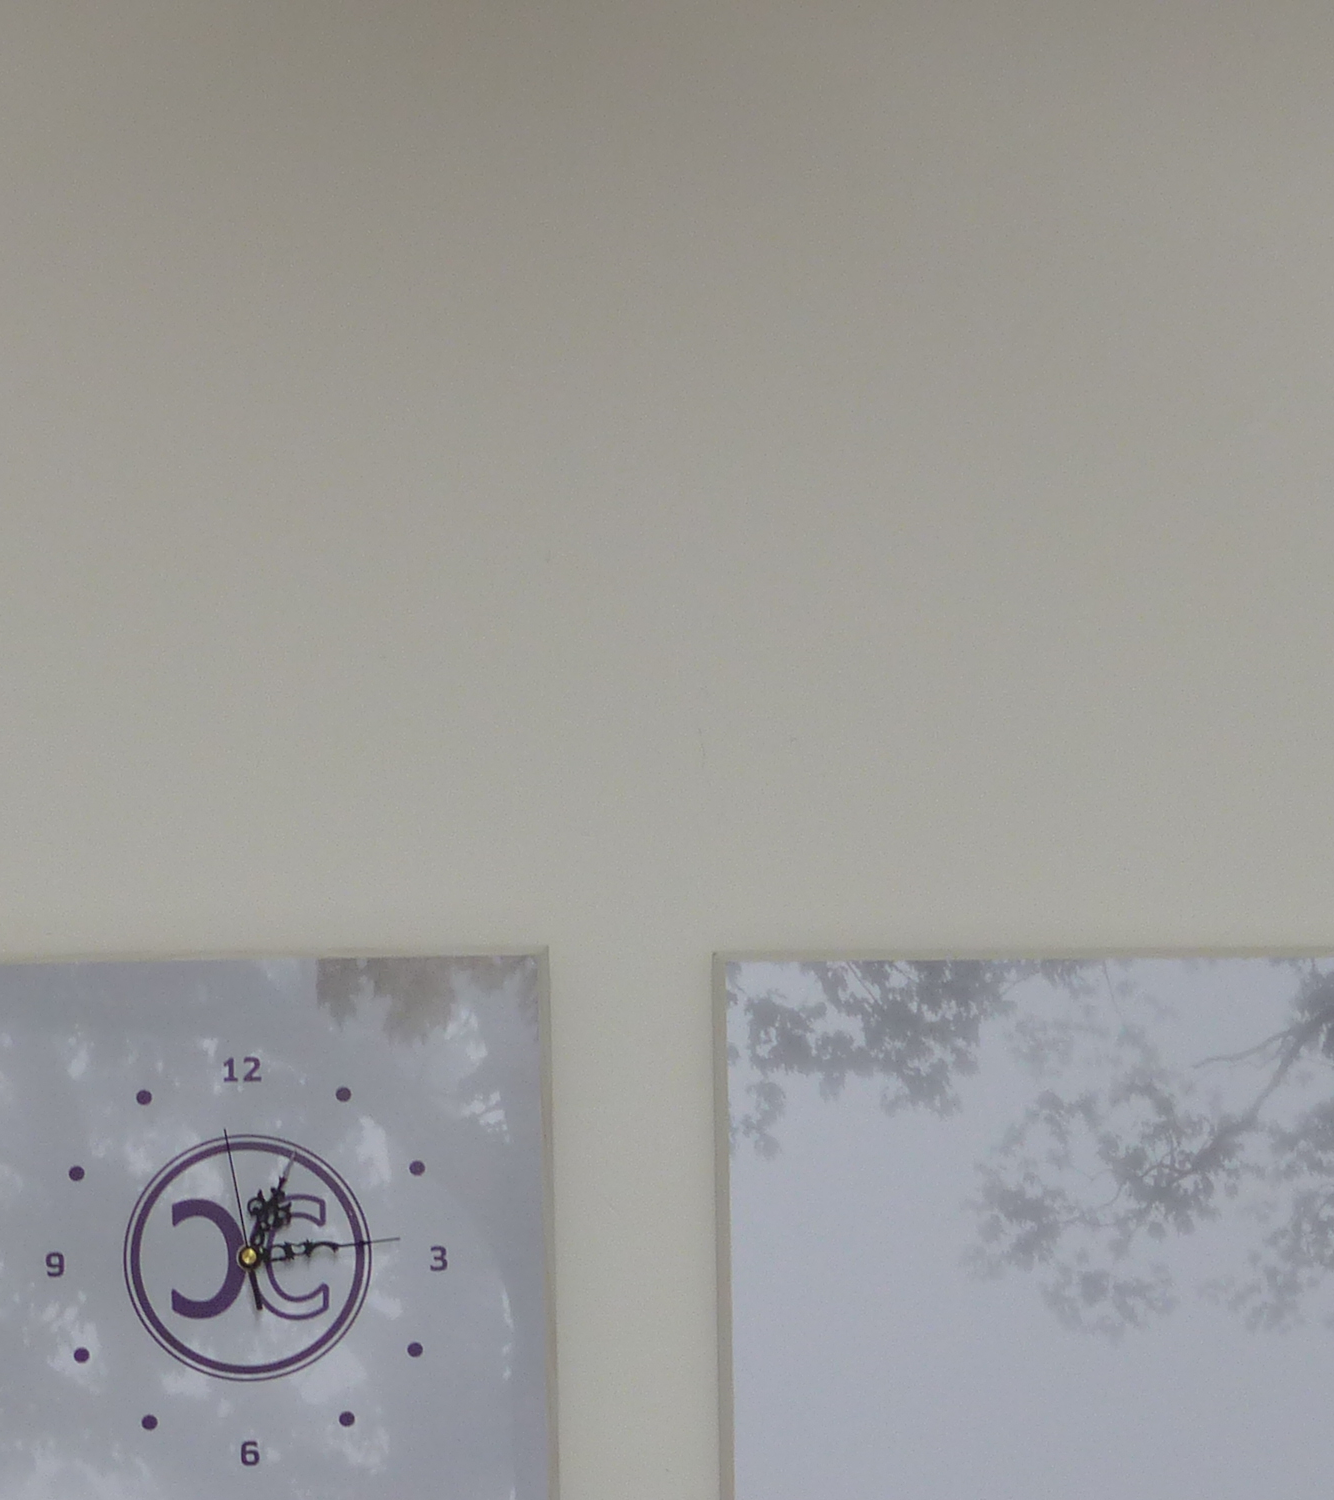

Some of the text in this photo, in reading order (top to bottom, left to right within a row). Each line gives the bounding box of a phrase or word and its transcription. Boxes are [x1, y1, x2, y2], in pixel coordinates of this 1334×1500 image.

[222, 1057, 263, 1084] 12
[45, 1252, 65, 1278] 9
[429, 1247, 449, 1272] 3
[240, 1442, 261, 1467] 6
